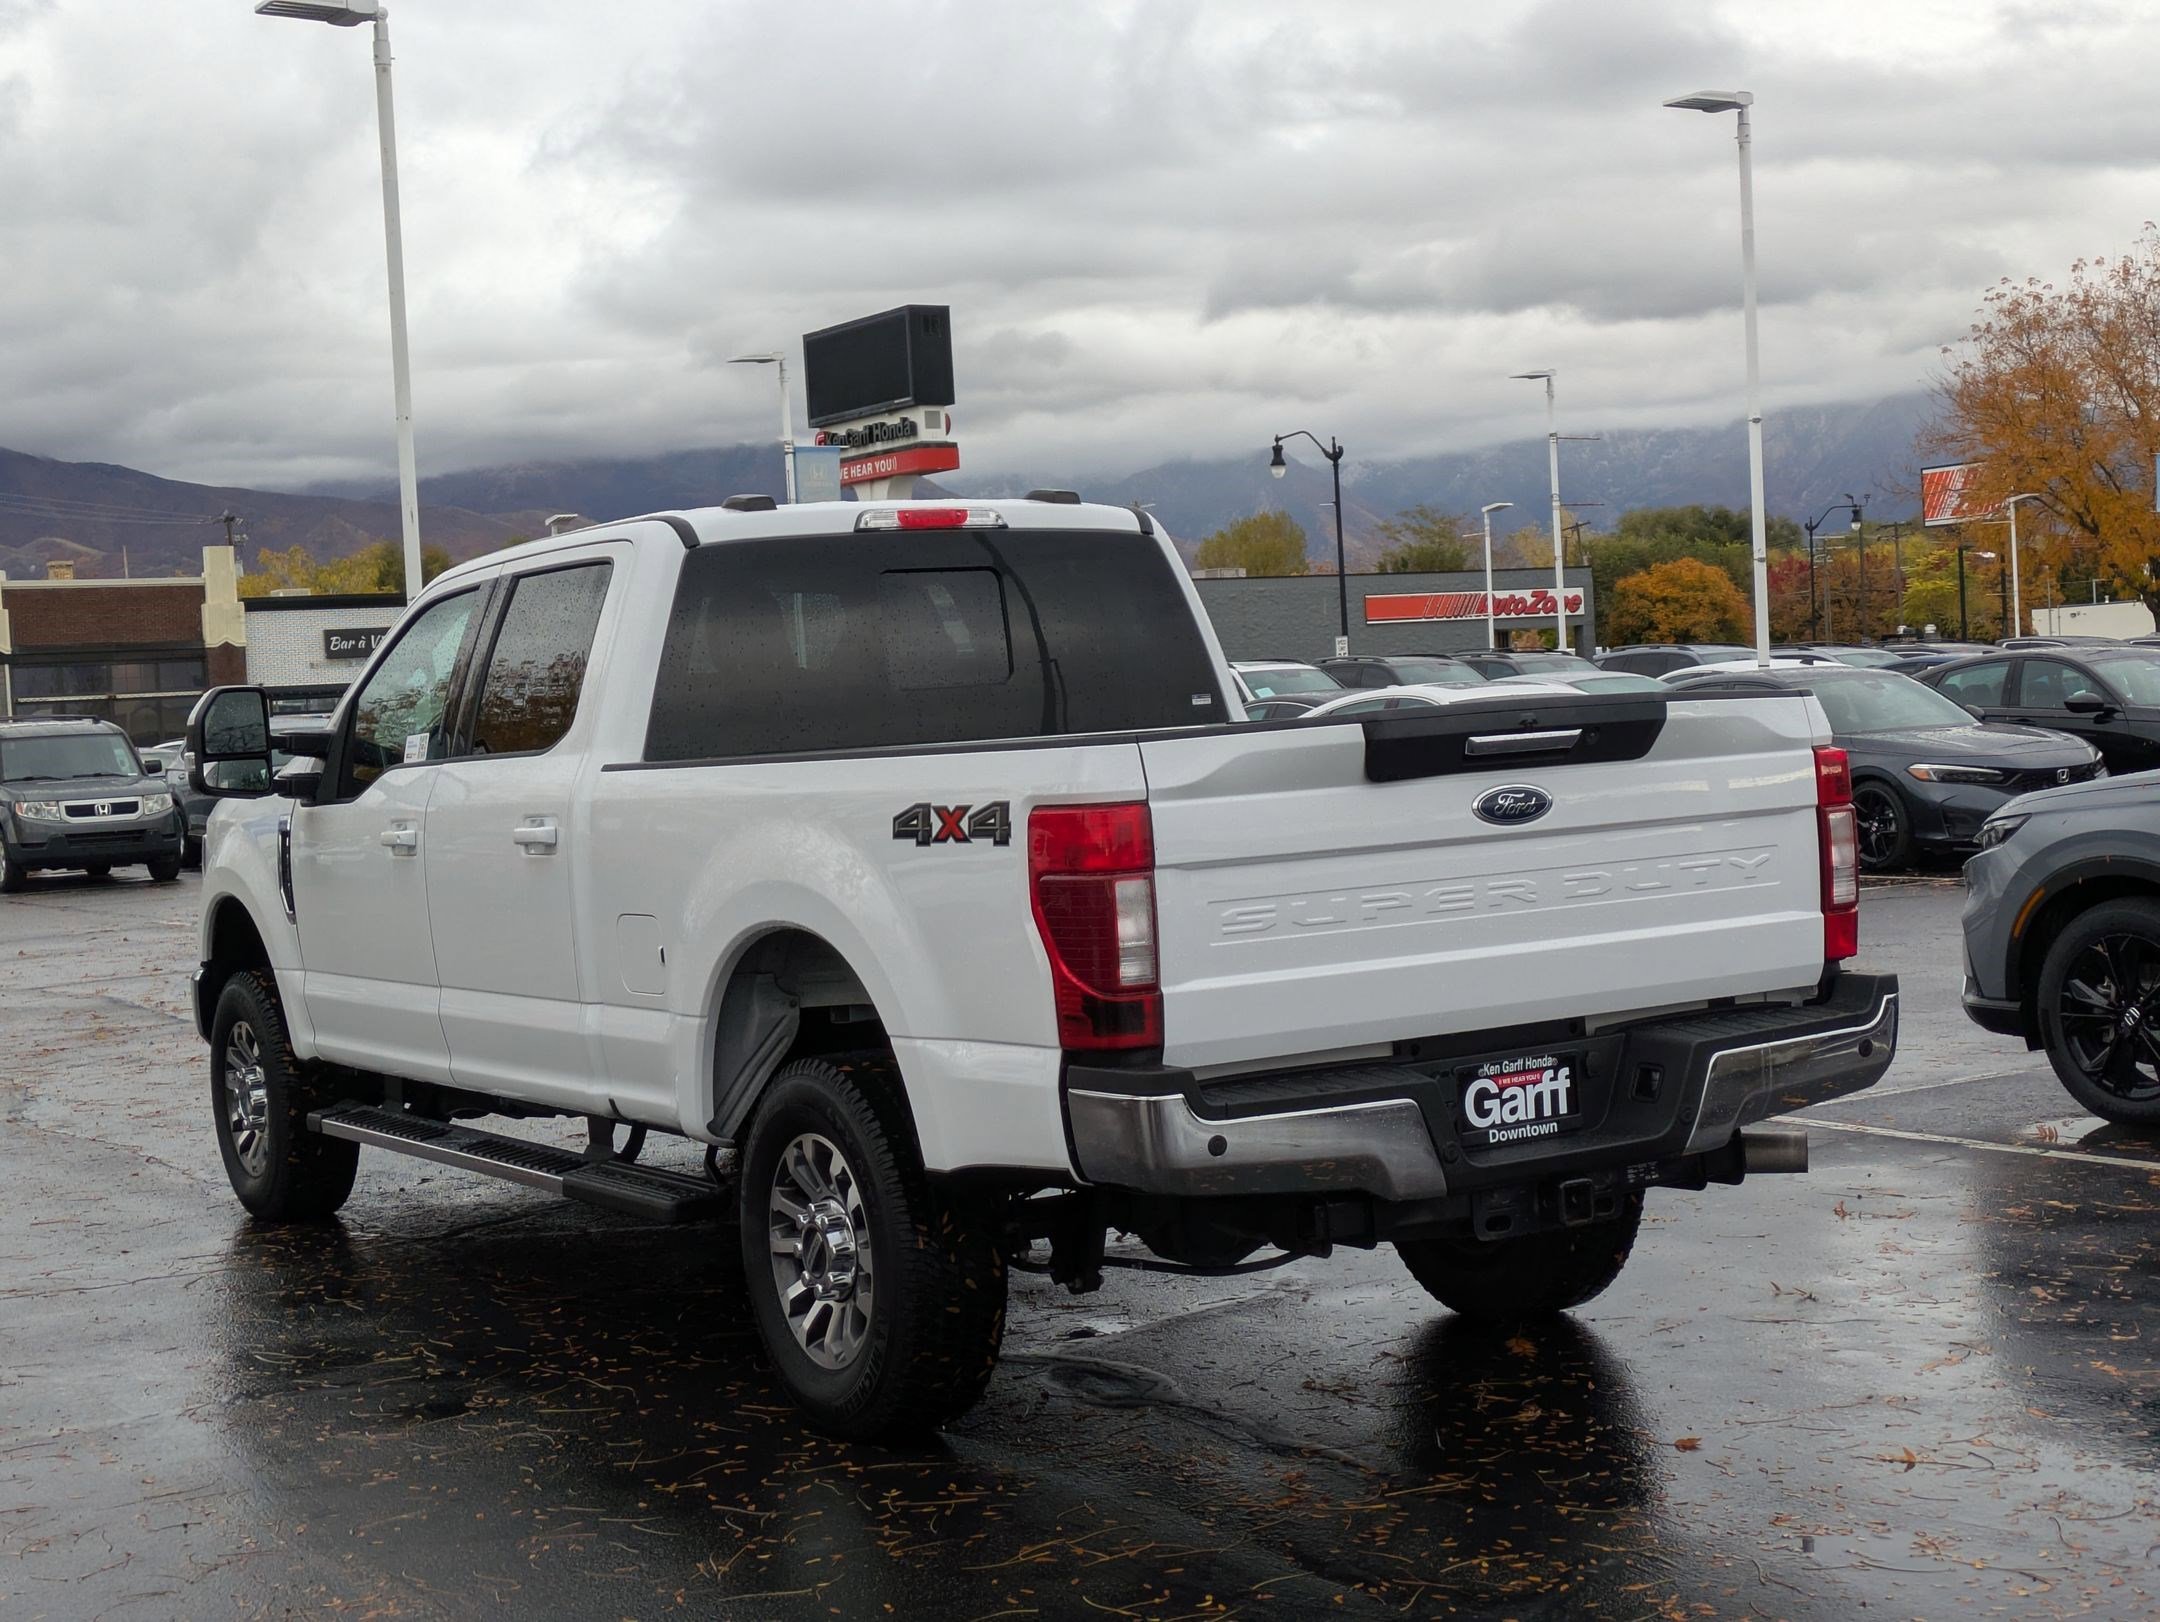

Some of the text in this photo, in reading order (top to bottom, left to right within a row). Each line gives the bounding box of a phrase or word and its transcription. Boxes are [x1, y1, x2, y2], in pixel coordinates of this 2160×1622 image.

[873, 417, 917, 443] Honda
[850, 462, 873, 478] HEAR
[874, 458, 892, 473] YOU
[330, 636, 355, 651] Bar
[358, 635, 366, 648] à
[1494, 793, 1536, 817] Ford
[1221, 852, 1771, 935] SUPER DUTY
[1484, 1054, 1553, 1076] Ken Garff Honda
[1511, 1075, 1526, 1083] HEAR
[1464, 1066, 1571, 1129] Garff
[1489, 1122, 1558, 1144] Downtown
